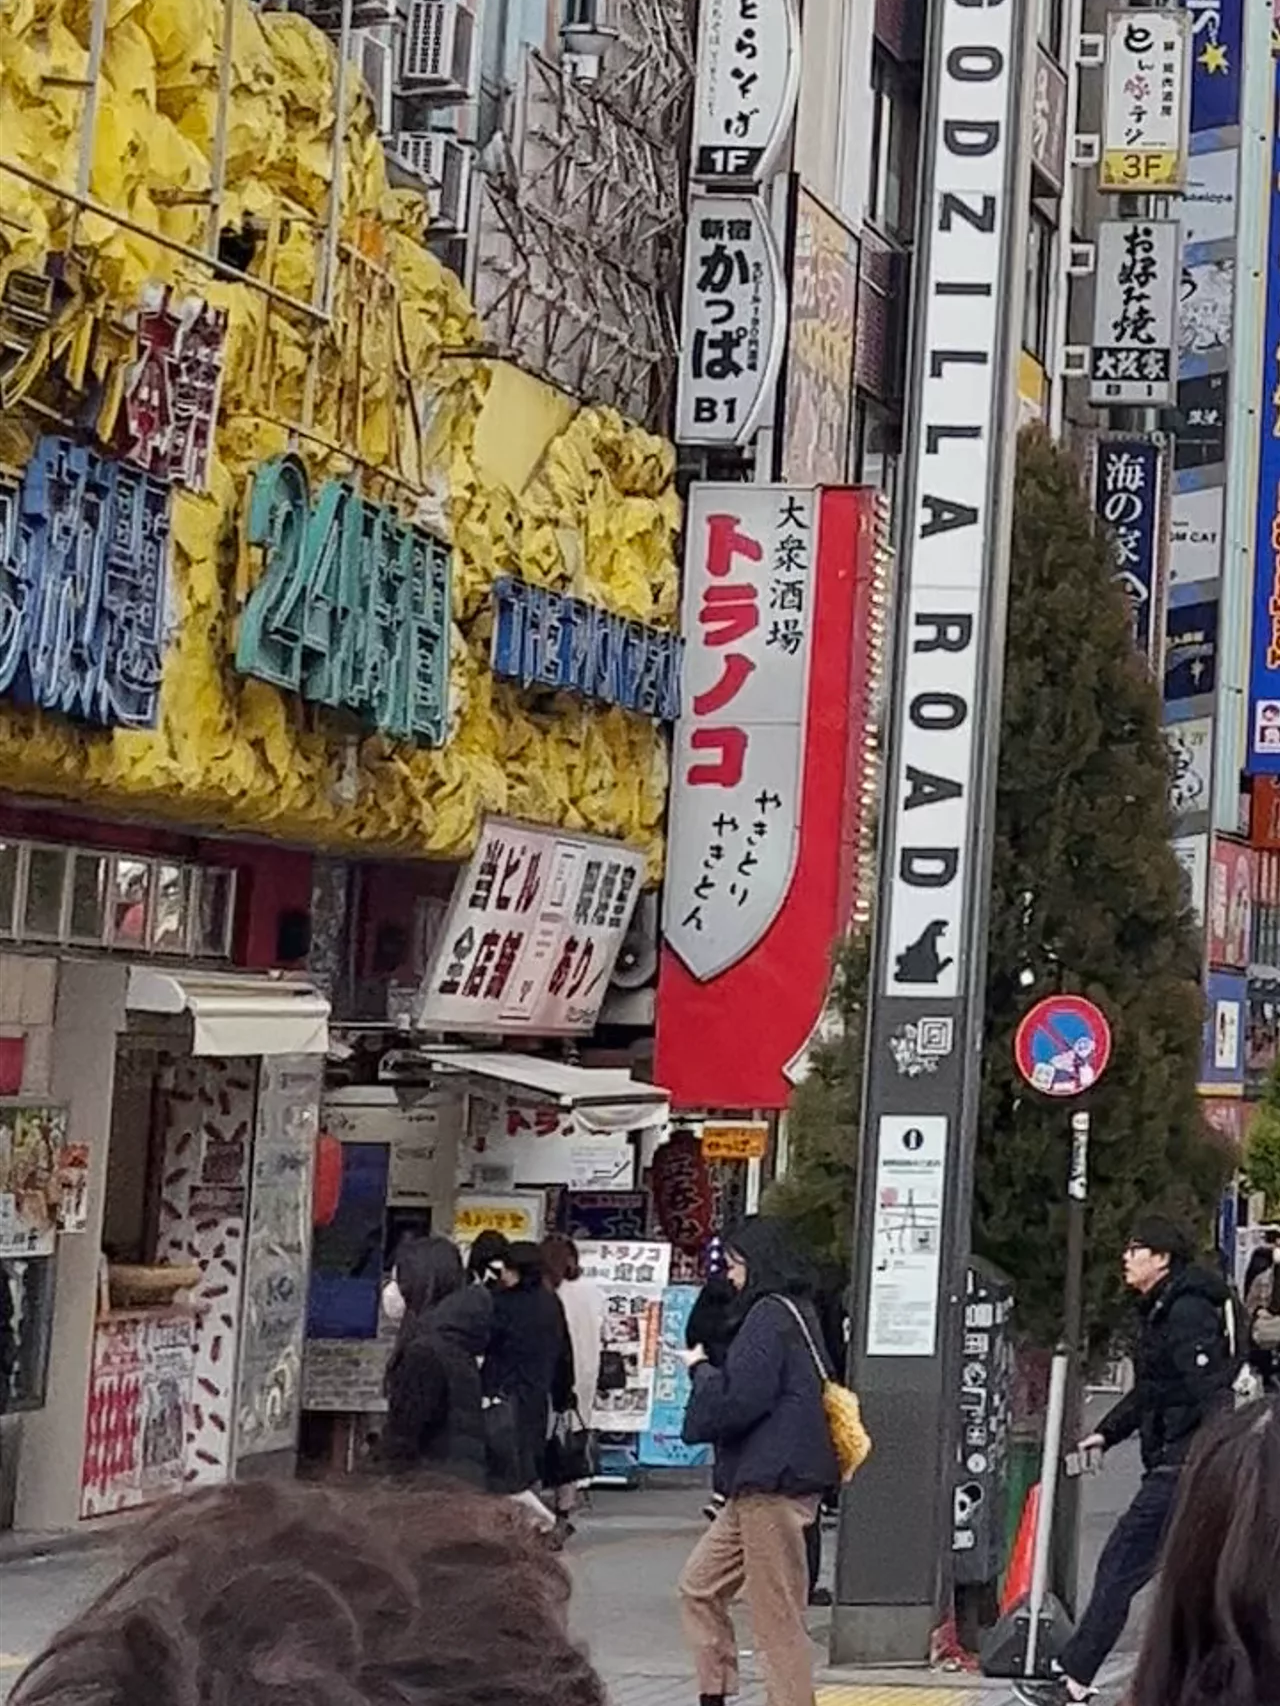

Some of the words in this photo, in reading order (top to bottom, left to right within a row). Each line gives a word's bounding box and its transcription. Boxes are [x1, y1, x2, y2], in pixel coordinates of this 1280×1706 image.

[710, 149, 748, 172] 1F
[1122, 154, 1164, 180] 3F
[700, 218, 752, 242] 新宿
[691, 242, 750, 381] かっぱ
[693, 397, 738, 425] B1
[765, 496, 811, 657] 大衆酒場
[688, 512, 764, 789] トラノコ
[898, 613, 974, 890] ROAD
[681, 812, 740, 931] やきとん
[728, 789, 781, 906] やきとり
